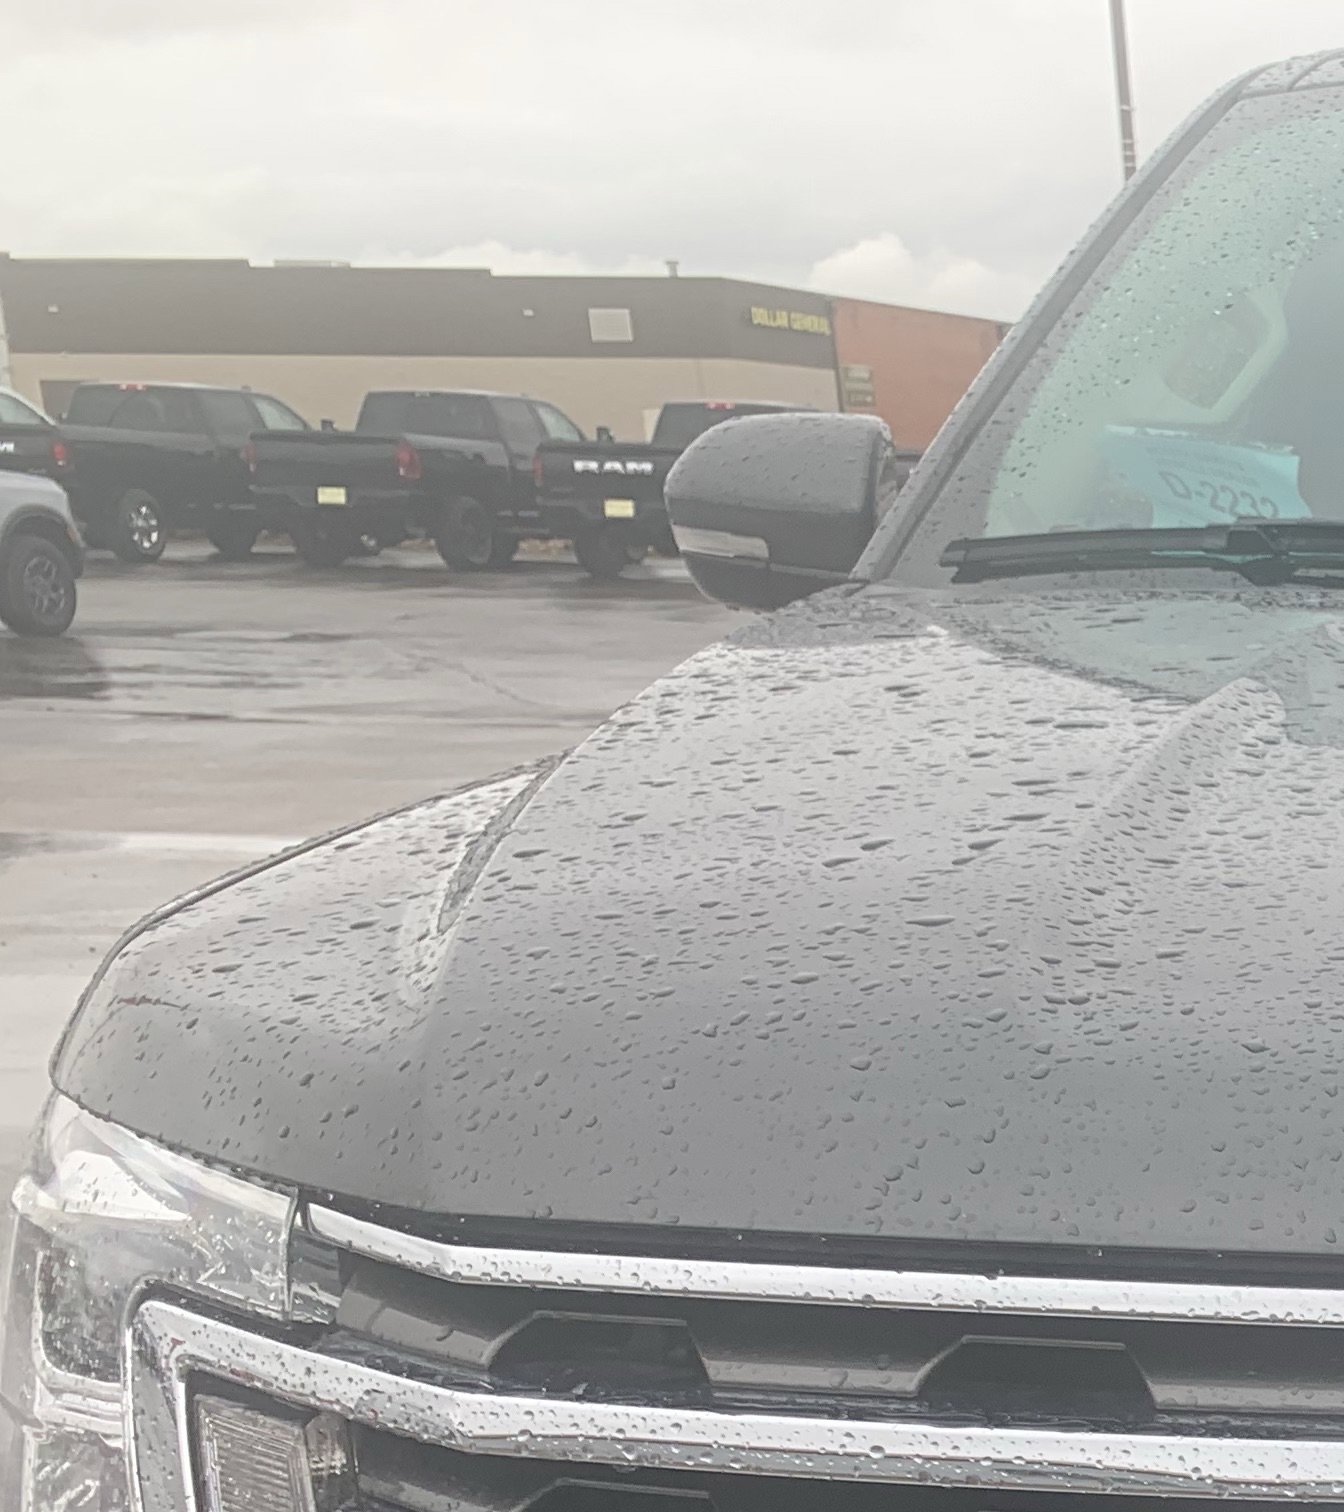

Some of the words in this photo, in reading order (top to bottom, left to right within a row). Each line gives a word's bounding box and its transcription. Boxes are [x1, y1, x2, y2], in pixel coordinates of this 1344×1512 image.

[751, 306, 788, 328] DOLLAR
[790, 311, 831, 336] GENERAL
[573, 460, 654, 475] RAM
